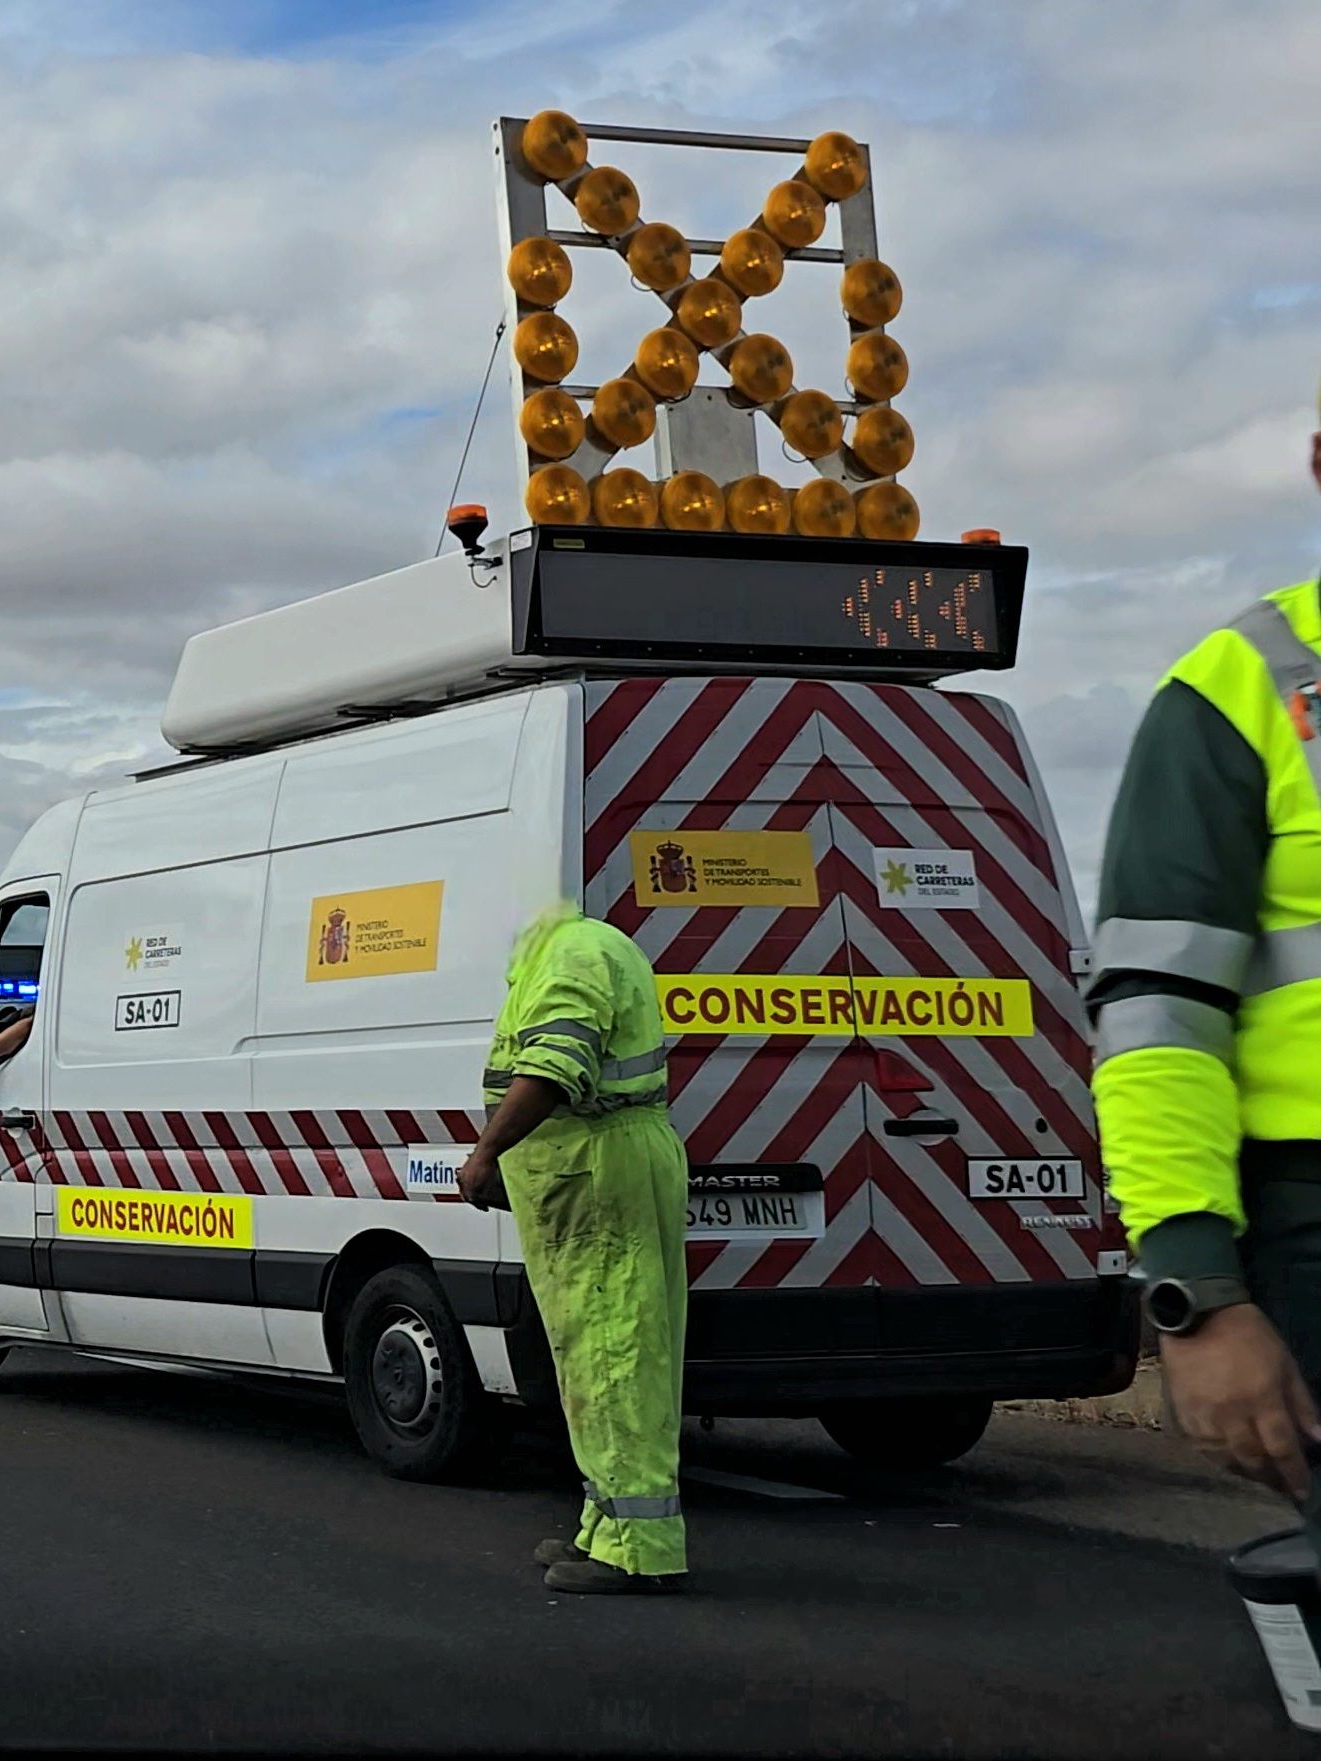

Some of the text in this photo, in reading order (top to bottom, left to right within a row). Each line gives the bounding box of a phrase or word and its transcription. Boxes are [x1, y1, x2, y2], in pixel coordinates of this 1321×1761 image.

[702, 858, 747, 867] MINISTERIO
[915, 864, 949, 874] RED DE
[916, 876, 975, 886] CARRETERAS
[124, 997, 170, 1025] SA-01
[665, 982, 1004, 1027] CONSERVACIÓN
[688, 1175, 780, 1188] MASTER
[985, 1163, 1068, 1193] SA-01
[72, 1198, 234, 1239] CONSERVACIÓN
[742, 1197, 798, 1226] MNH
